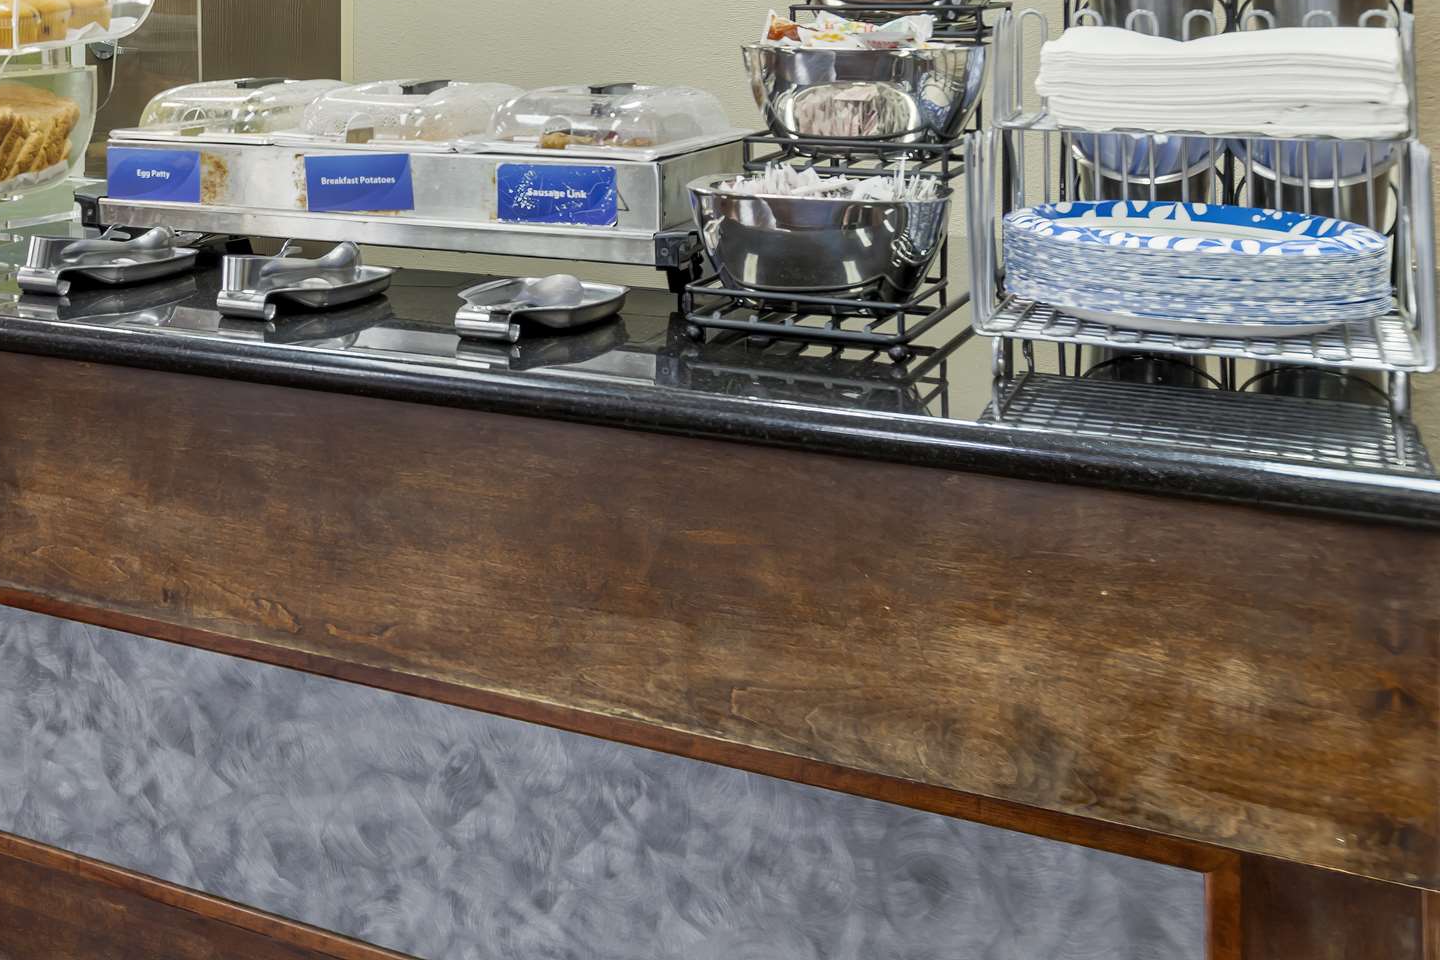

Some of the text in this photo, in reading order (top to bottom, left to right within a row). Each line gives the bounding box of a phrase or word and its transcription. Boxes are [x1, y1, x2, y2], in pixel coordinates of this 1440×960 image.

[136, 168, 171, 180] Egg Patty
[320, 176, 396, 185] Breakfast Potatoes
[527, 187, 588, 200] Sausage Link
